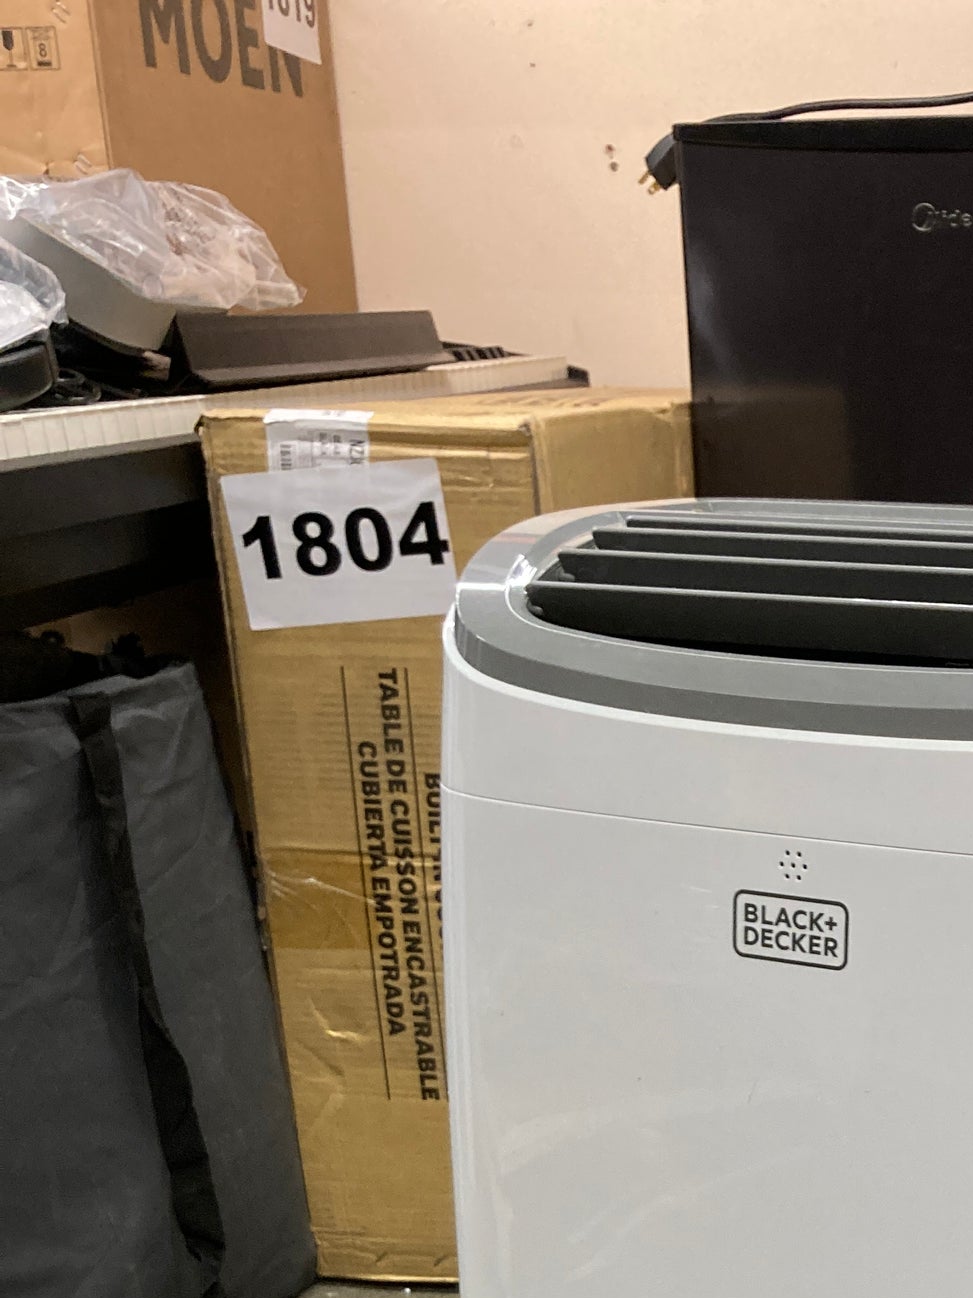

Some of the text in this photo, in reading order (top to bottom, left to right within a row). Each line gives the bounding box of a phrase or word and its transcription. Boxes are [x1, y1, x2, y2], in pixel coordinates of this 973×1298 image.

[242, 501, 449, 580] 1804
[357, 740, 407, 1037] CUBIERTA EMPOTRADA
[378, 667, 440, 1101] TABLE DE CUISSON ENCASTRABLE
[744, 902, 838, 933] BLACK+
[744, 926, 838, 958] DECKER
